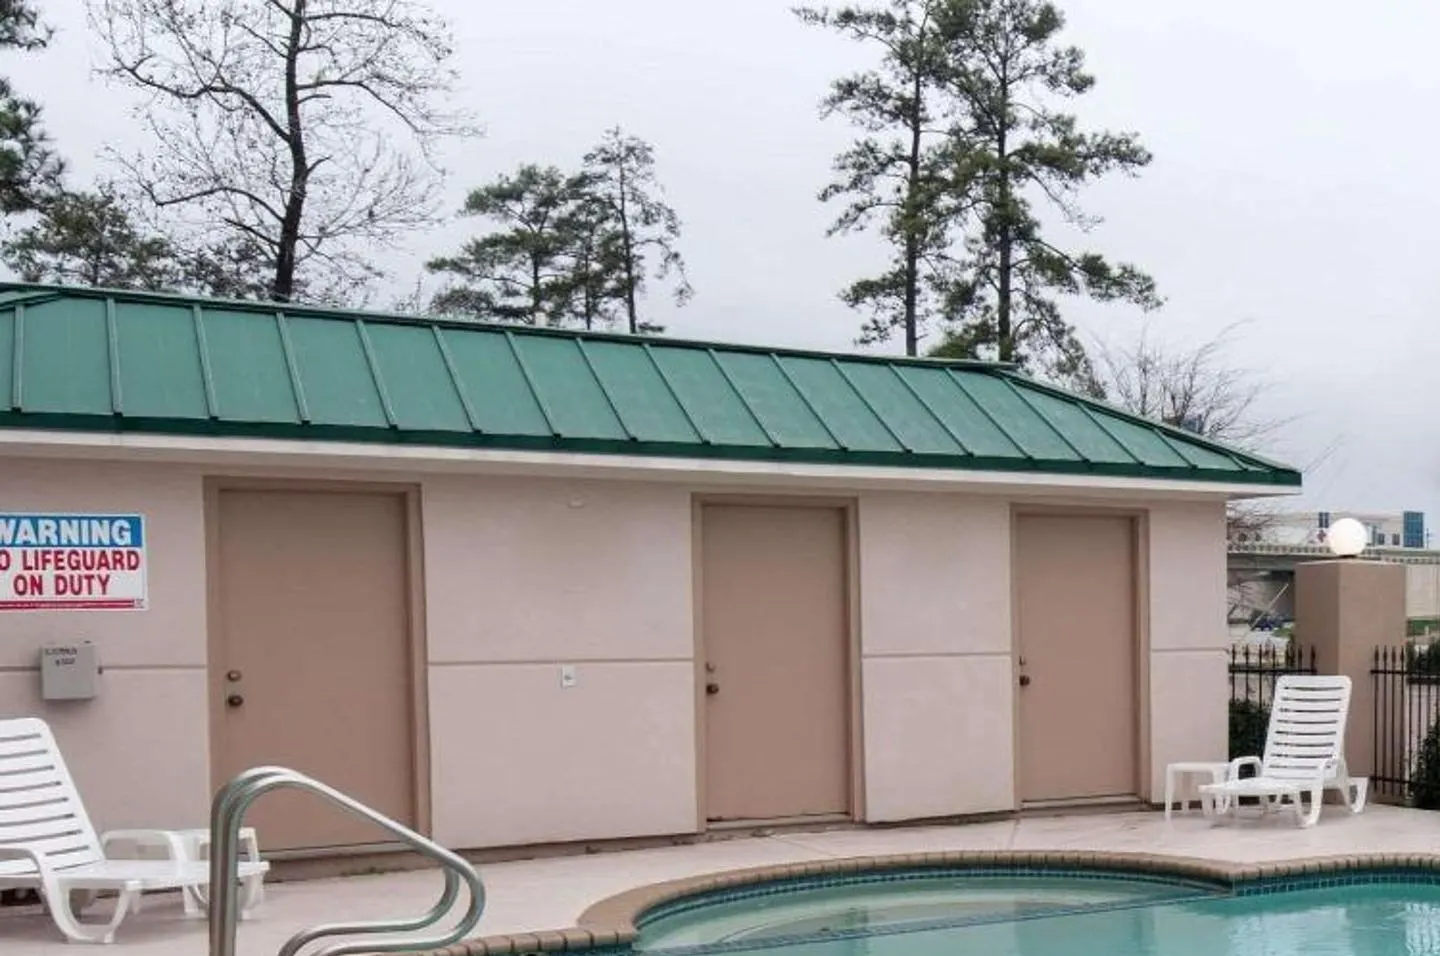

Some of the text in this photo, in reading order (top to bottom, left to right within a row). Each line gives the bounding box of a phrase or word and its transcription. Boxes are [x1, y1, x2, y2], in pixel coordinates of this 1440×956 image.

[0, 518, 132, 545] WARNING
[22, 549, 140, 571] LIFEGUARD
[13, 574, 110, 596] ON DUTY
